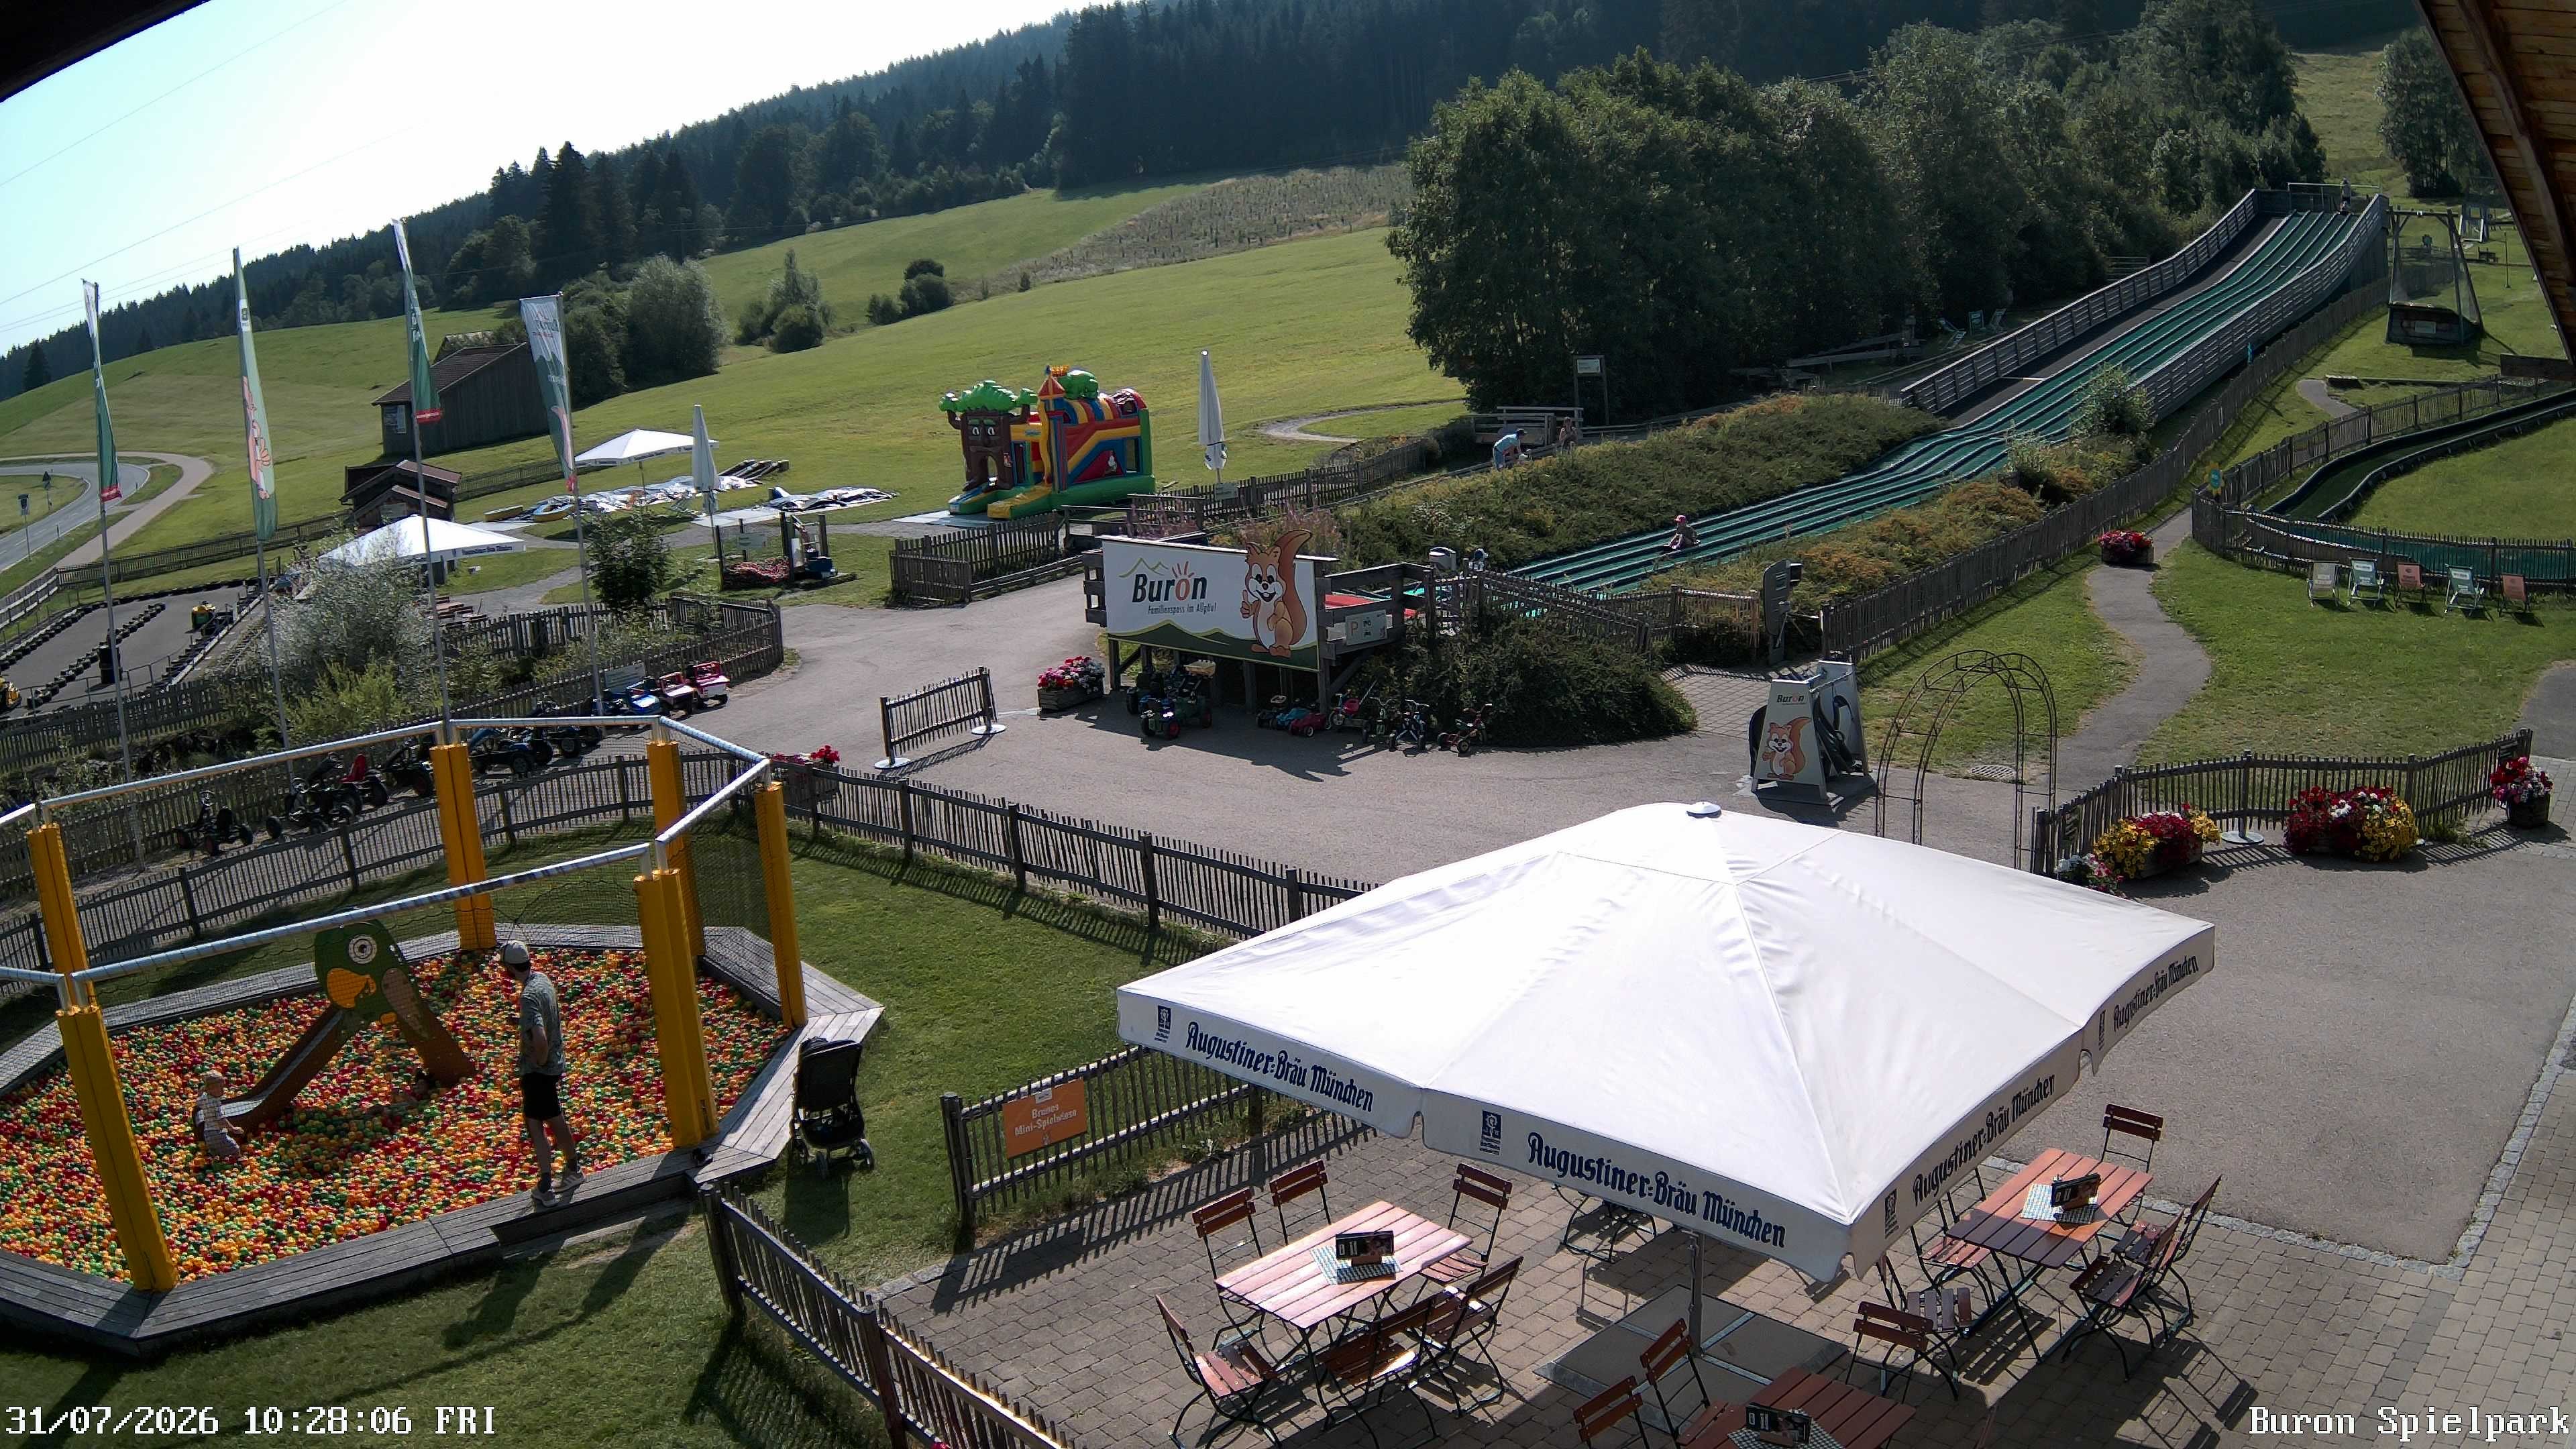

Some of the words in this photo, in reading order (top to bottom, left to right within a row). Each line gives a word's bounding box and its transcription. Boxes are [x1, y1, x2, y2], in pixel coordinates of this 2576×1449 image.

[1132, 573, 1208, 603] Buron
[1776, 694, 1805, 703] Buron
[1310, 1064, 1373, 1112] München
[2012, 1074, 2055, 1123] München
[1703, 1190, 1786, 1248] München
